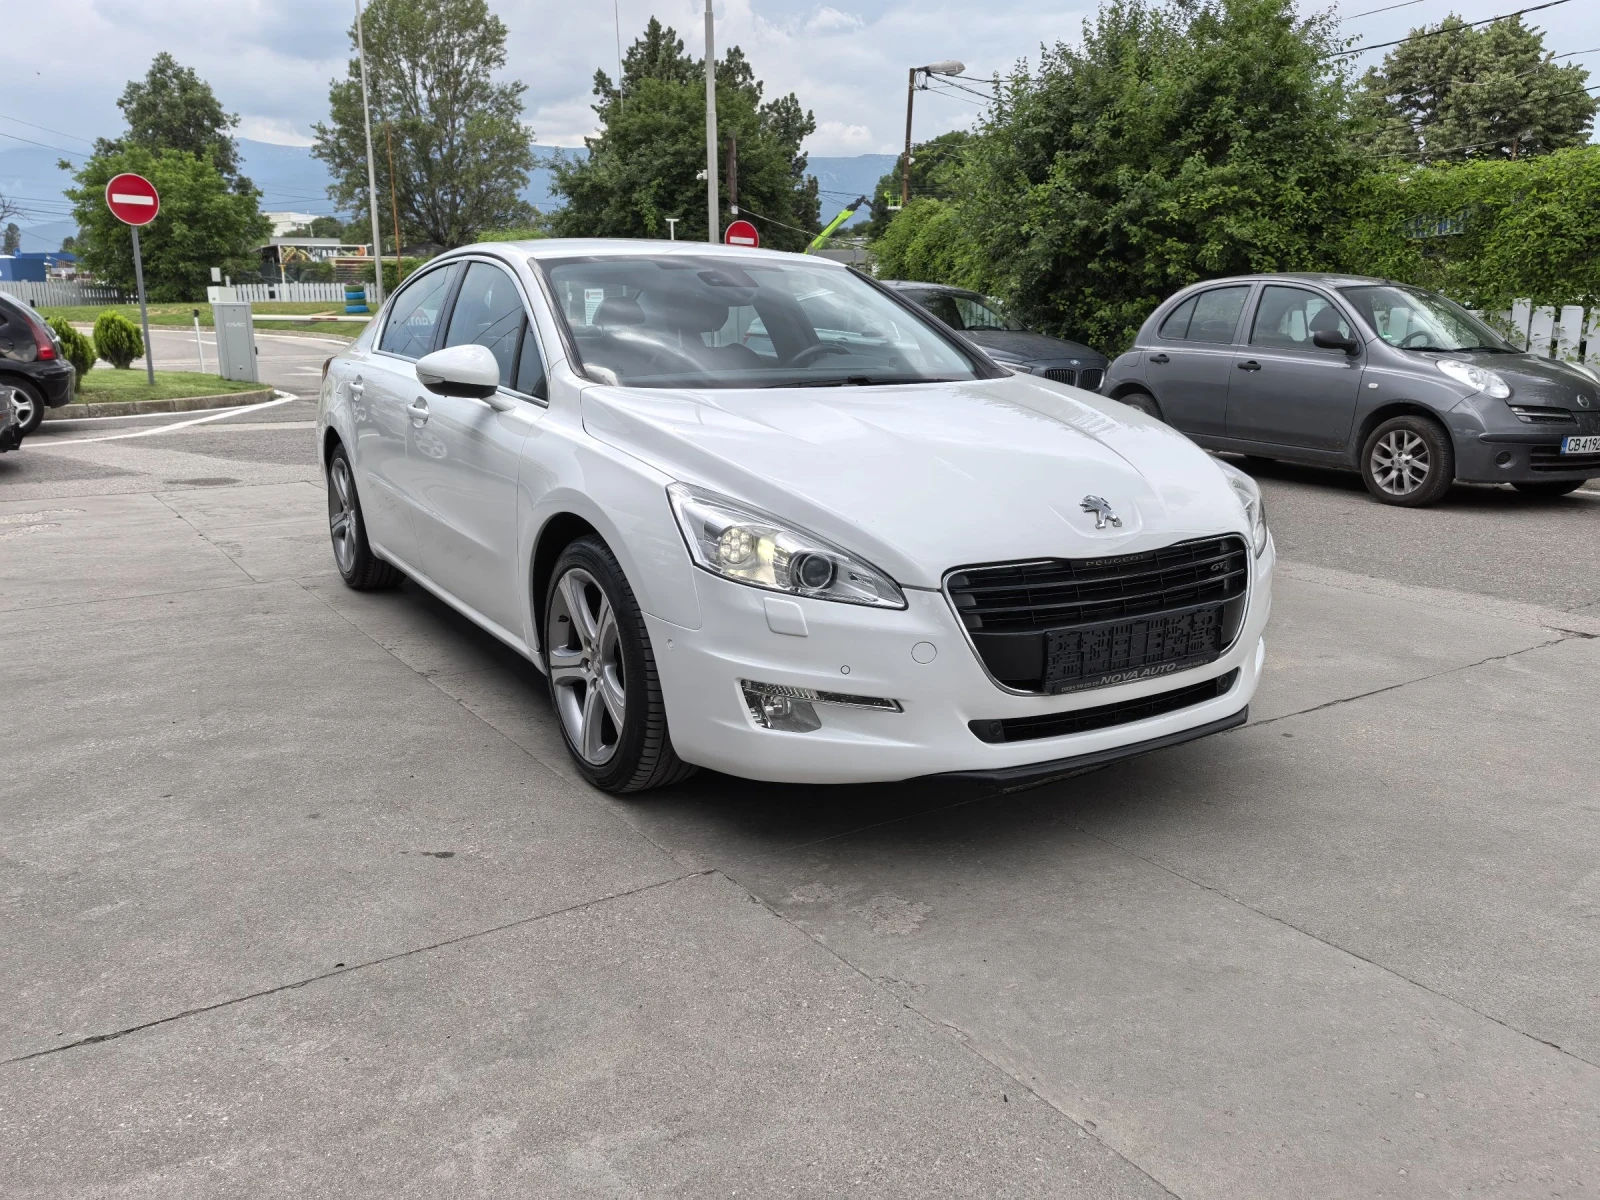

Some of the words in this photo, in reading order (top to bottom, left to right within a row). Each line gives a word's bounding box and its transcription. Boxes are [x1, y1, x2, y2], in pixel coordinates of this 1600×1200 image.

[1086, 555, 1144, 566] PEUGEOT
[1210, 560, 1227, 571] GT
[1100, 670, 1138, 684] NOVA
[1140, 662, 1177, 677] AUTO
